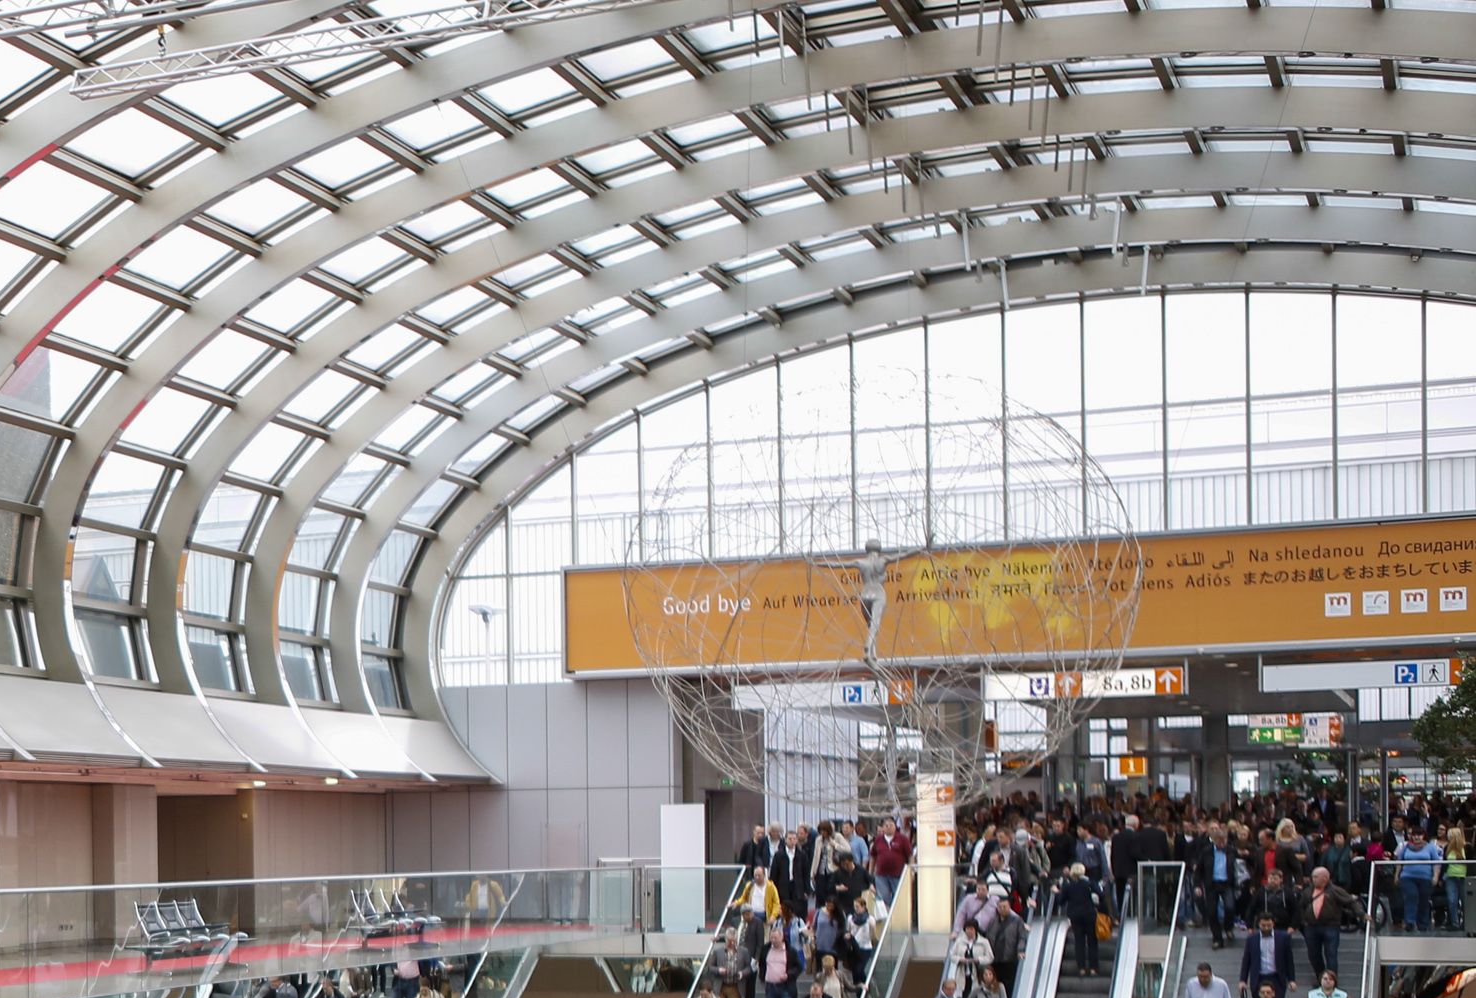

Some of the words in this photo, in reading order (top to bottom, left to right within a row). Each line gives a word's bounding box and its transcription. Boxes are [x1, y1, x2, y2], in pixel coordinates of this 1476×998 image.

[1248, 549, 1269, 562] Na
[1275, 545, 1364, 561] shledanou
[1377, 541, 1400, 557] До
[1185, 573, 1232, 588] Adiós
[663, 593, 711, 615] Good
[718, 593, 752, 616] bye
[763, 595, 787, 609] Auf
